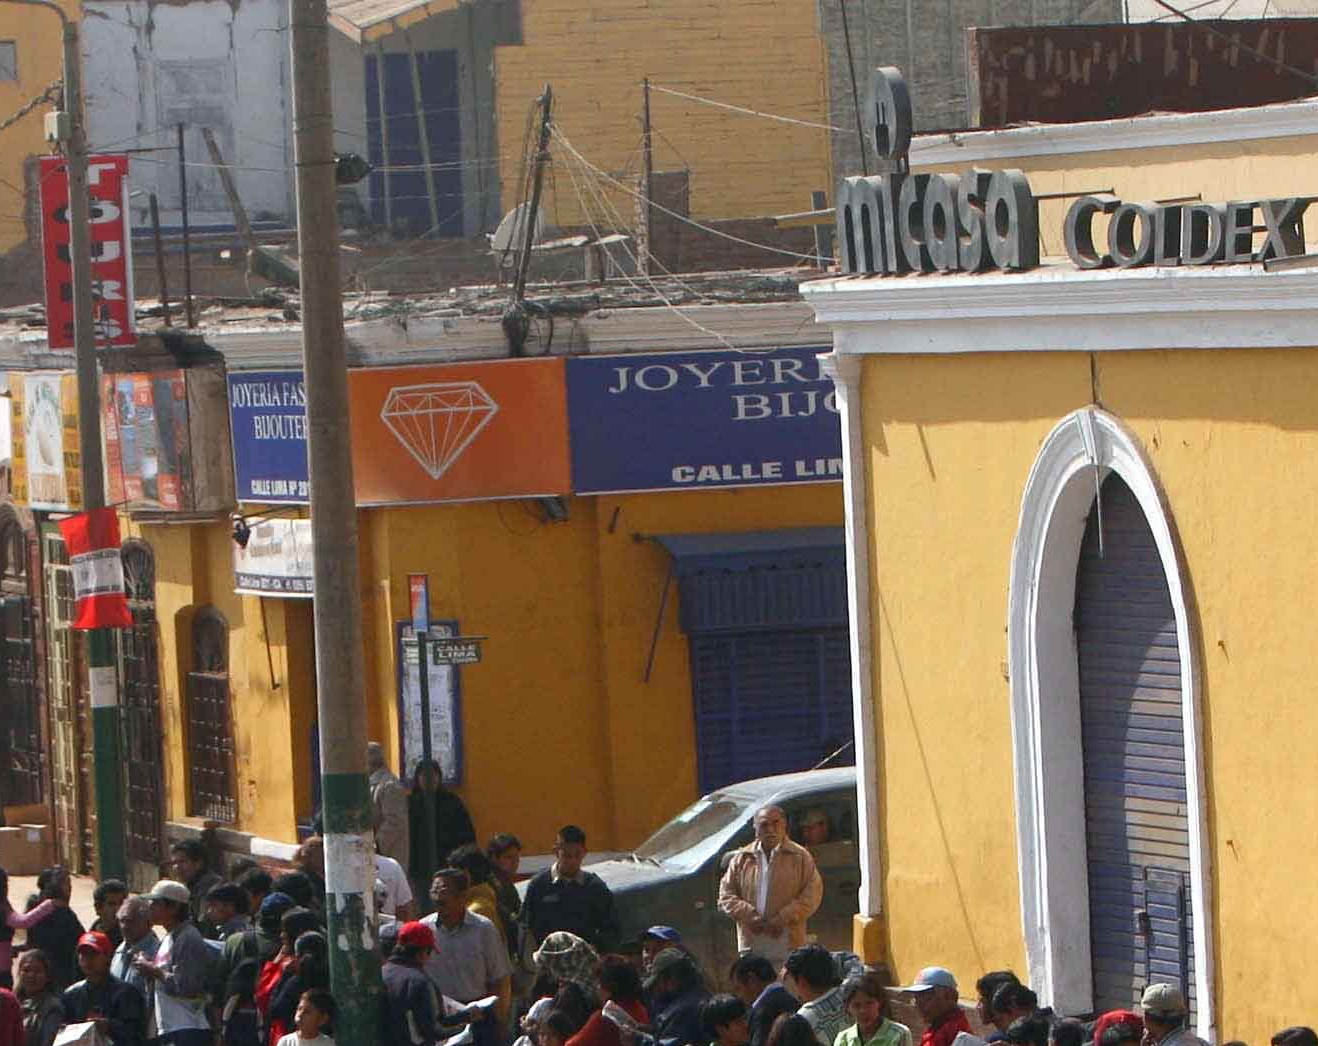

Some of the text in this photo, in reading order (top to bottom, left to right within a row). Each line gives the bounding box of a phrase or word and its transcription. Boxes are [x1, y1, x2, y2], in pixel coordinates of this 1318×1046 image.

[1063, 193, 1309, 272] COLDEX
[672, 461, 782, 482] CALLE
[437, 644, 475, 652] CALLE
[439, 651, 477, 659] LIMA
